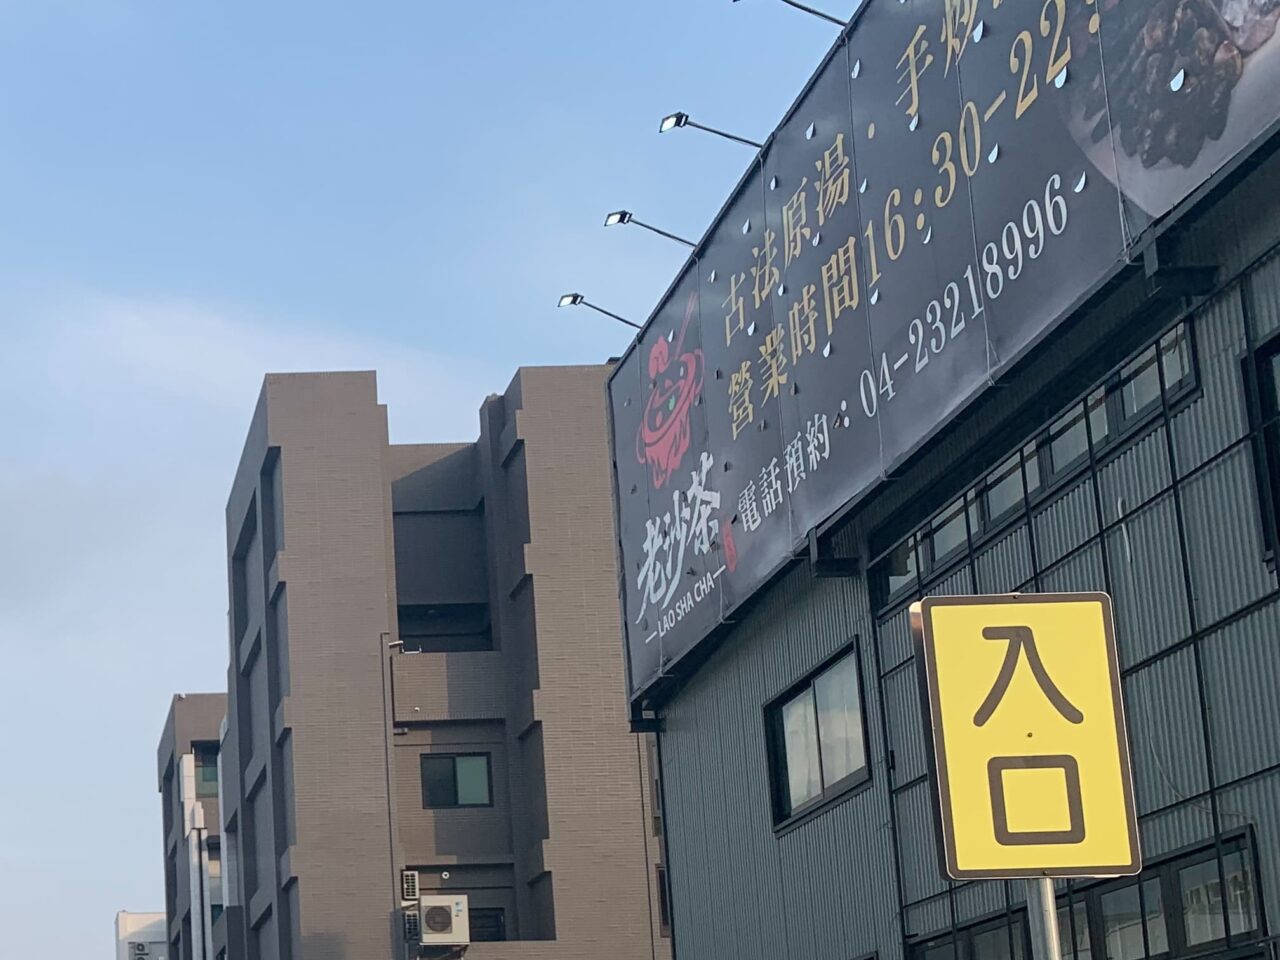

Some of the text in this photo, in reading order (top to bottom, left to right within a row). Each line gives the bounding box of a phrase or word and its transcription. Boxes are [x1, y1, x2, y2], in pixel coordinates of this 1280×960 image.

[658, 572, 715, 637] LAO SHA CHA
[973, 625, 1086, 846] 入口
